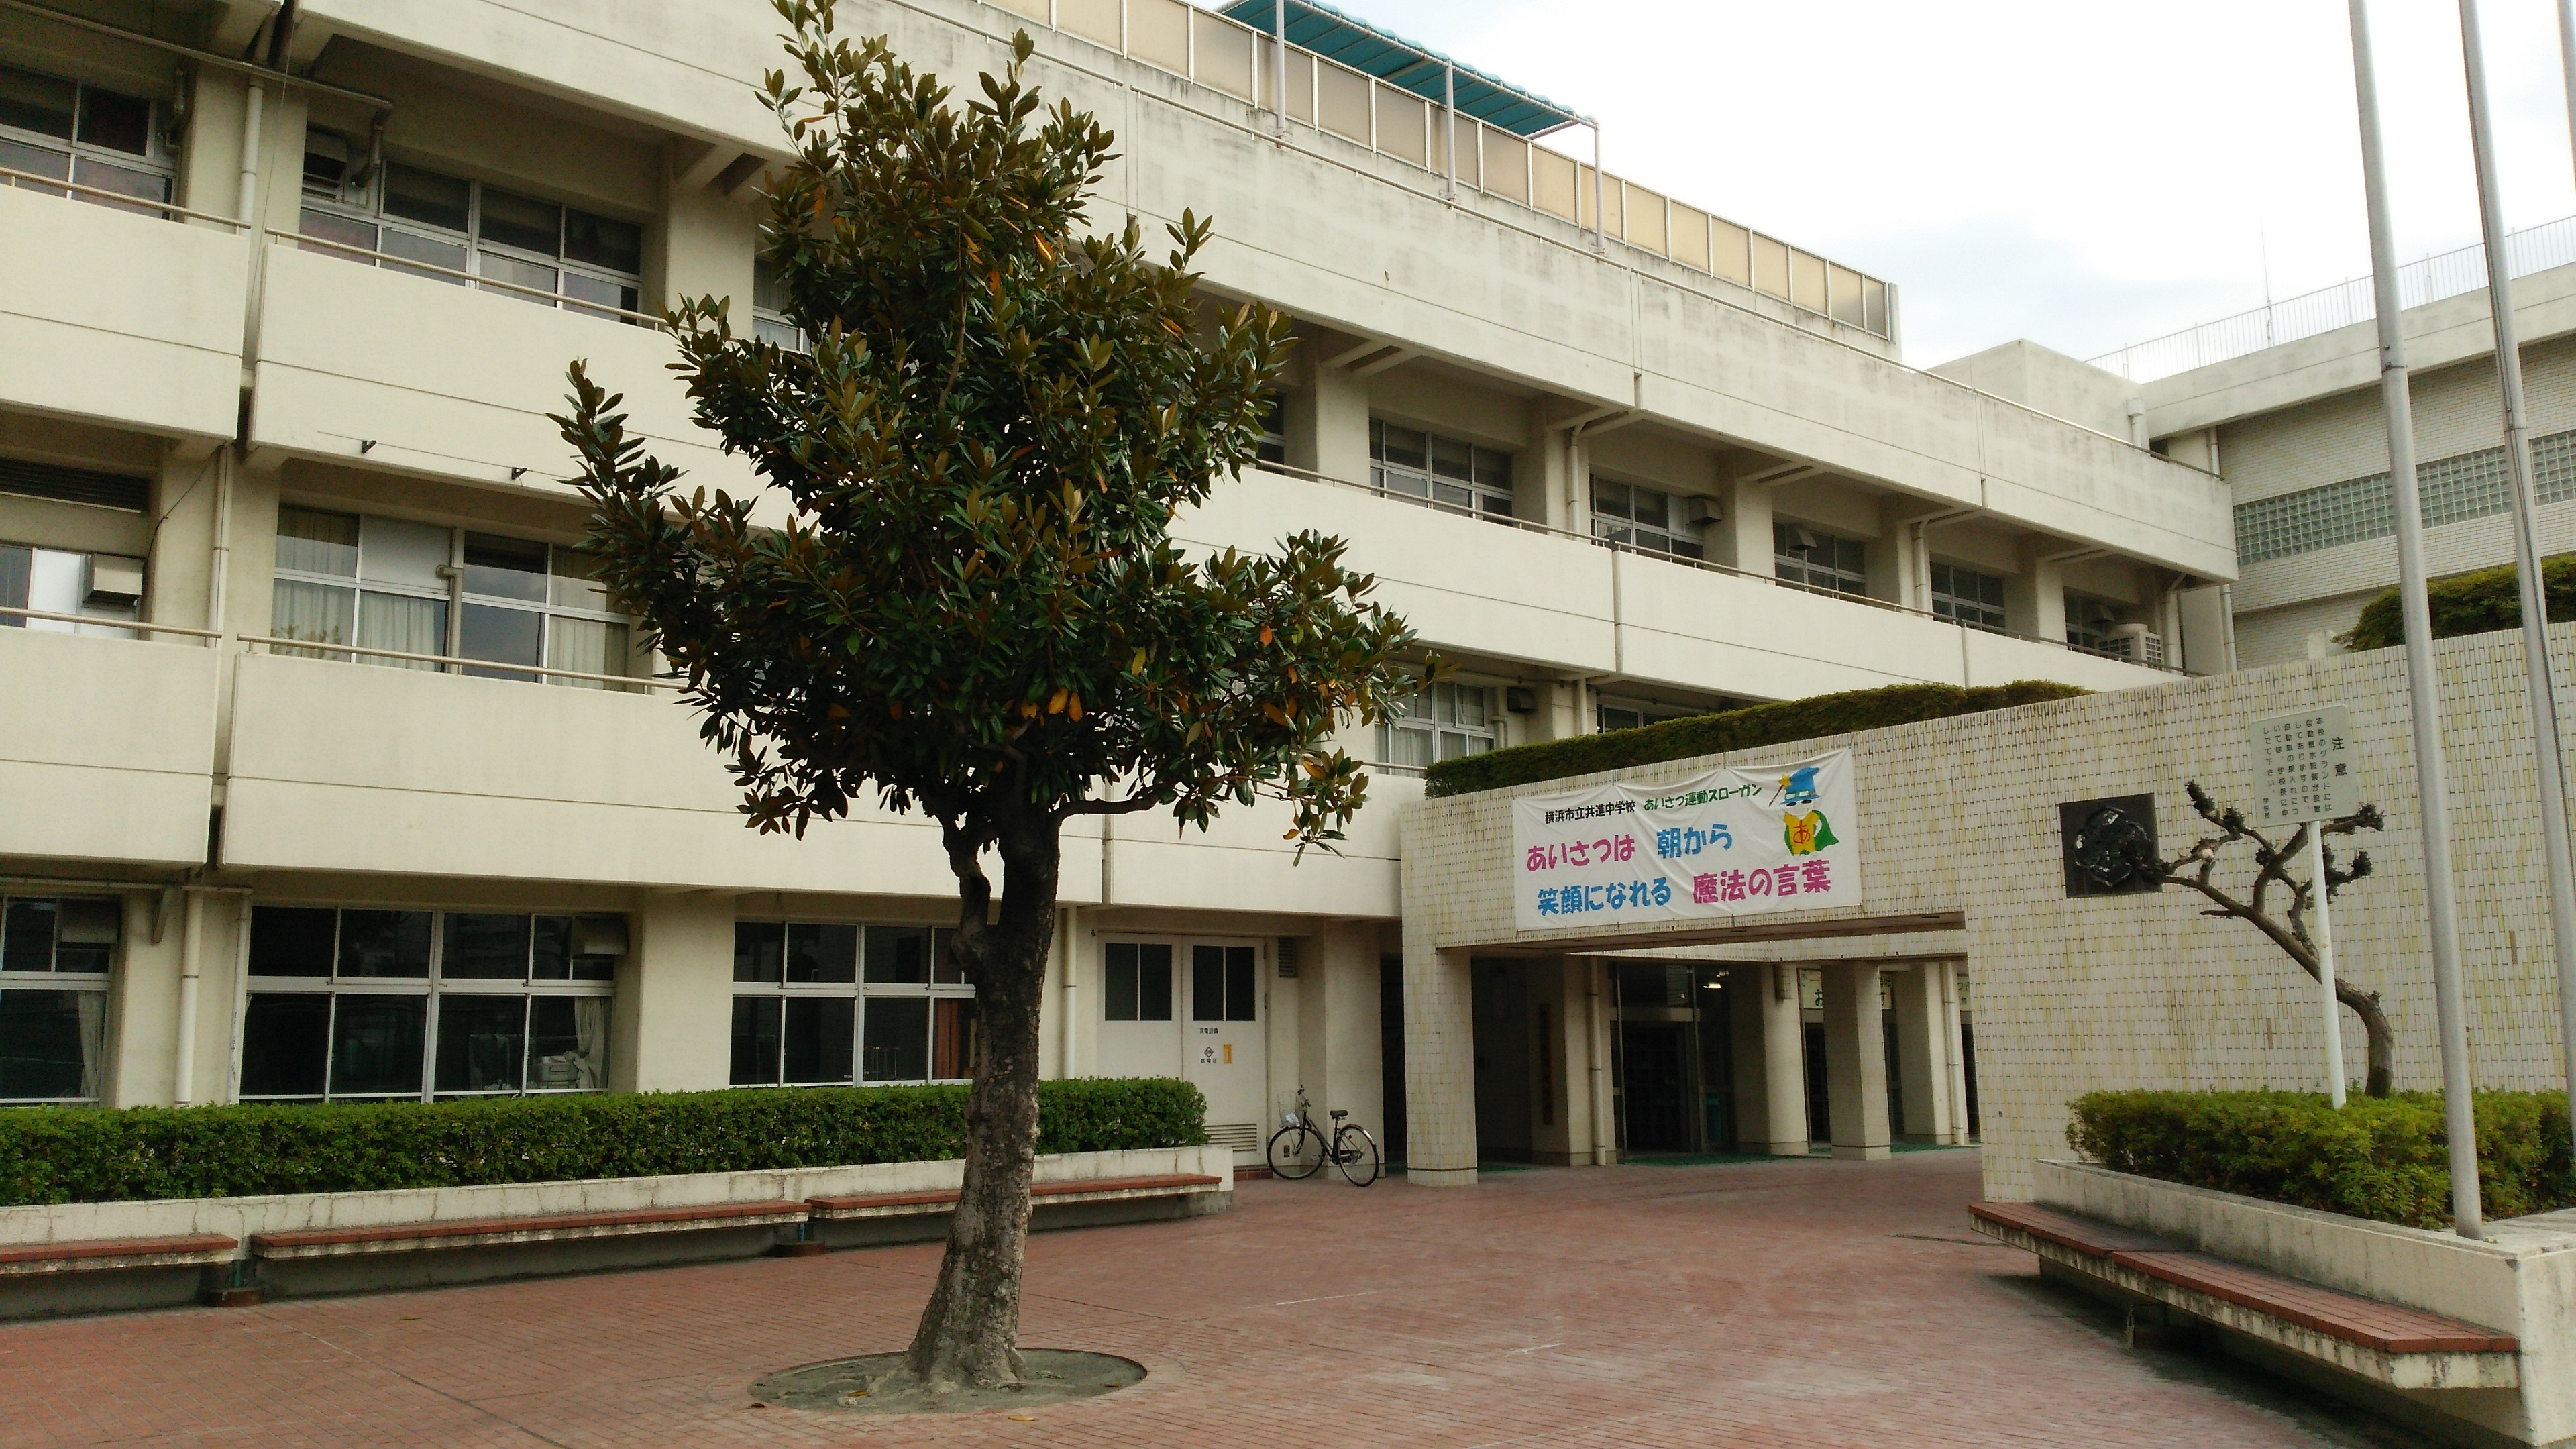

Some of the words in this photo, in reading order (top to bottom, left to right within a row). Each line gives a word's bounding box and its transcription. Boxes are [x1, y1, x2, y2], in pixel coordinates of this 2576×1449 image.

[2332, 737, 2348, 777] 注意
[1545, 800, 1636, 824] 横浜市立共進中学校
[1644, 784, 1762, 811] あいさつ運動スローガン
[1527, 834, 1635, 871] あいさつは
[1656, 824, 1733, 859] 朝から
[1793, 820, 1811, 844] あ
[1538, 877, 1672, 916] 笑顔になれる
[1693, 859, 1831, 904] 魔法の言葉
